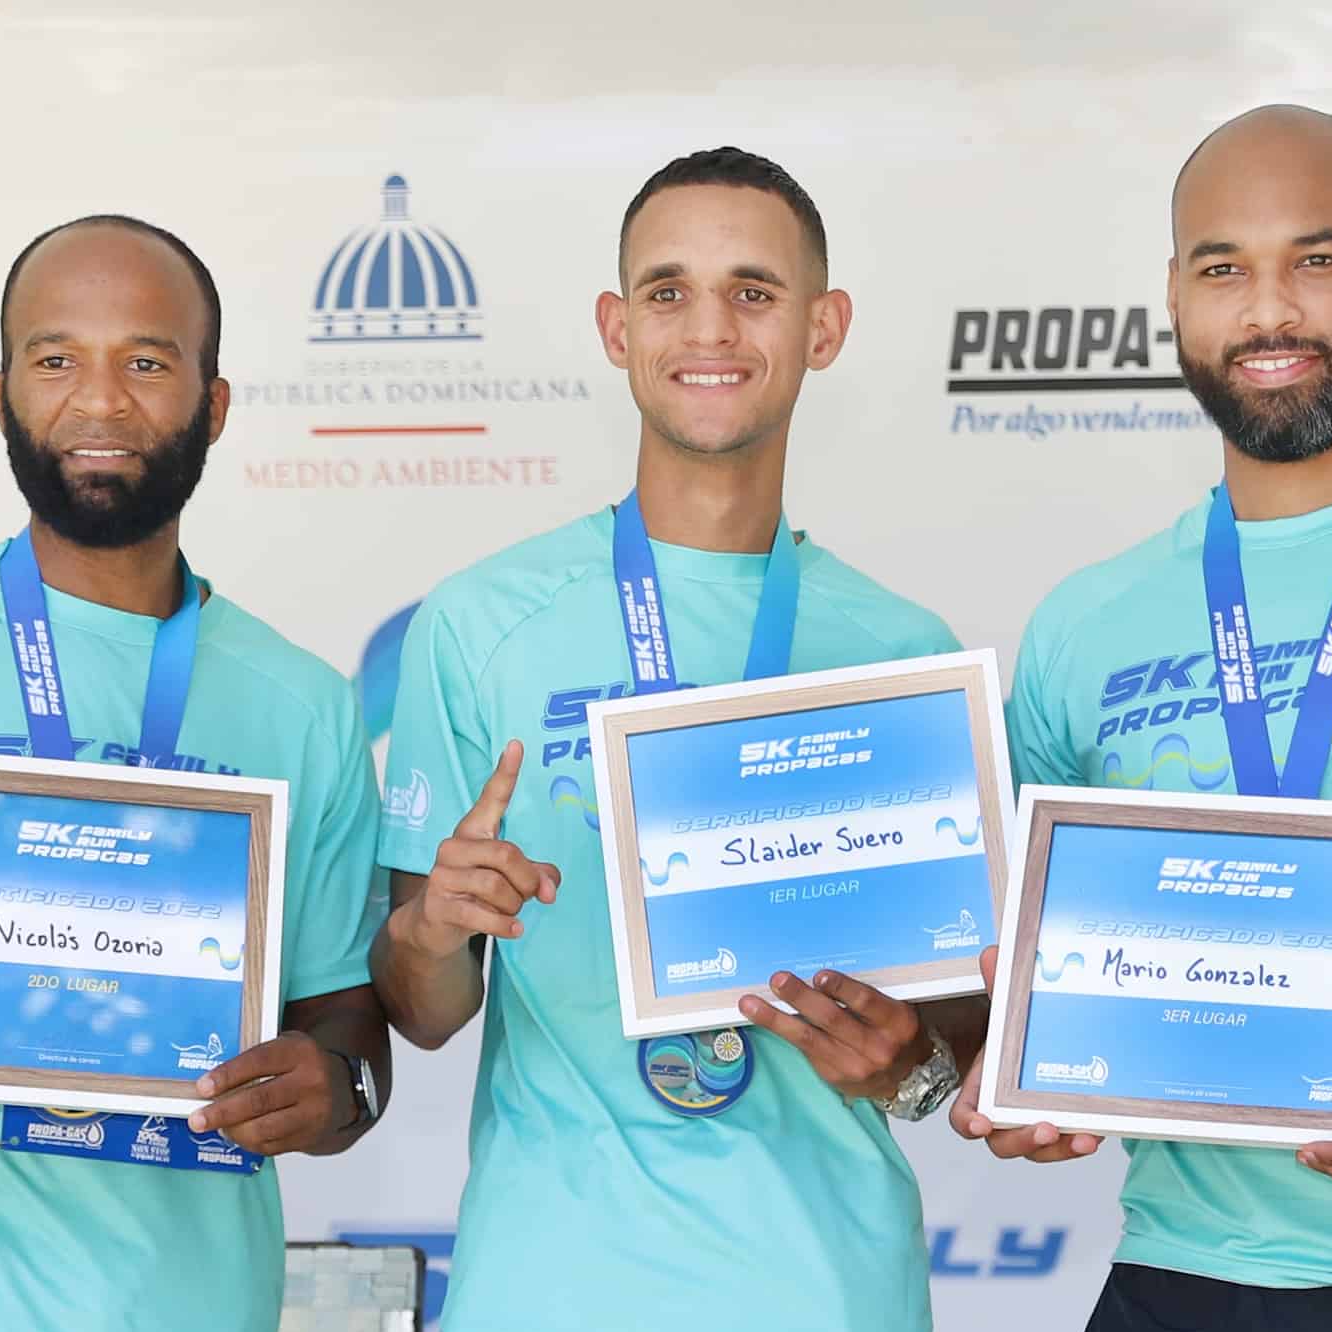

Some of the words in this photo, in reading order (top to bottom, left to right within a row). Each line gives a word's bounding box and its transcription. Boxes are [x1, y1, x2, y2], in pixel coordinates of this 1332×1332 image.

[384, 376, 592, 404] DOMINICANA
[950, 403, 999, 434] Por
[1004, 403, 1065, 440] algo
[243, 460, 361, 490] MEDIO
[371, 456, 560, 487] AMBIENTE
[1232, 604, 1257, 700] PROPAGAS
[799, 728, 871, 746] FAMILY
[796, 743, 837, 757] RUN
[740, 750, 873, 779] PROPAGAS
[868, 784, 952, 809] 2022
[75, 836, 117, 849] RUN
[79, 826, 153, 841] FAMILY
[17, 843, 152, 866] PROPAGAS
[721, 833, 824, 866] Slaider
[836, 827, 904, 852] Suero
[1218, 871, 1261, 883] RUN
[1223, 861, 1299, 875] FAMILY
[802, 880, 860, 900] LUGAR
[1157, 880, 1295, 899] PROPAGAS
[140, 897, 223, 920] 2022
[94, 930, 164, 957] Ozoria
[1102, 947, 1168, 988] Mario
[1185, 957, 1291, 989] Gonzalez
[28, 974, 60, 990] 2DO
[66, 976, 120, 994] LUGAR
[1162, 1008, 1190, 1024] 3ER
[1193, 1010, 1248, 1028] LUGAR
